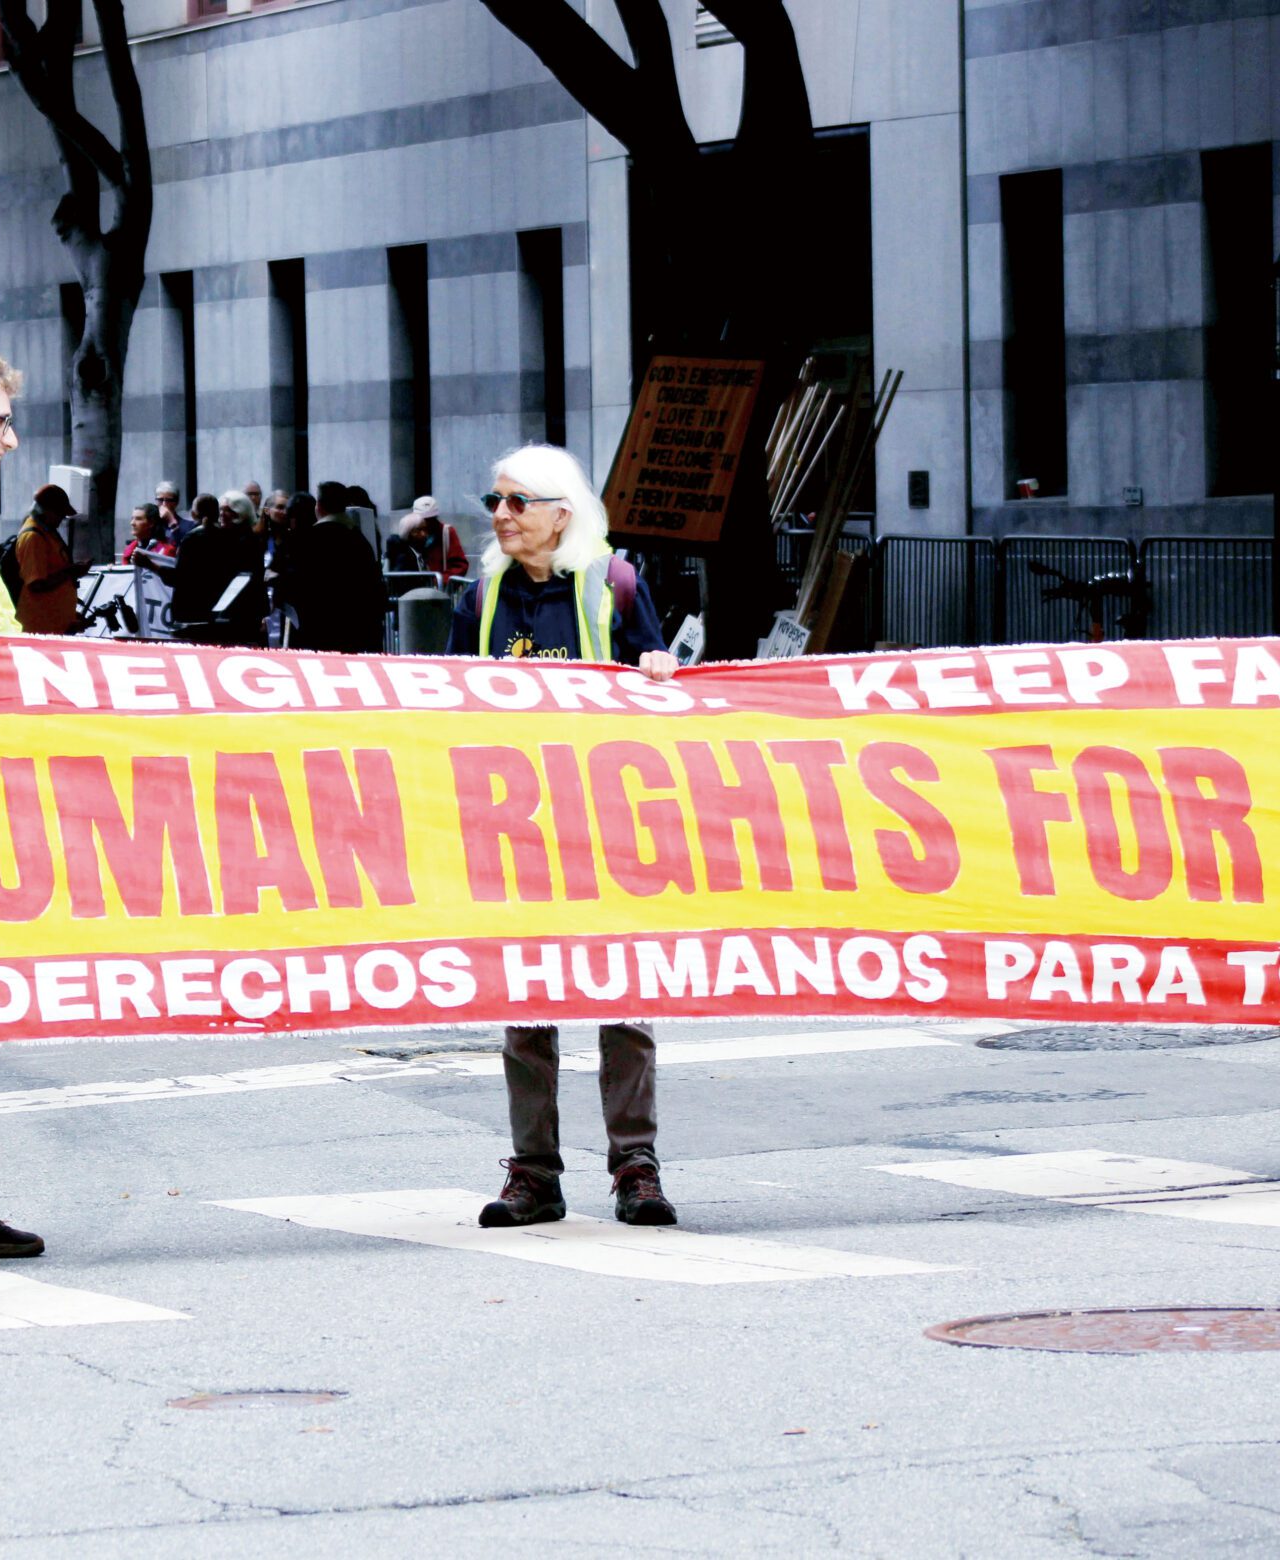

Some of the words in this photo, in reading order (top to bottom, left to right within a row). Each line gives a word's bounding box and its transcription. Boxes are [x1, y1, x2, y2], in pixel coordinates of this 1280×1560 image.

[657, 407, 695, 426] LOVE
[652, 427, 726, 449] NEIGHBOR
[646, 448, 714, 469] WELCOME
[631, 488, 673, 508] EVERY
[11, 647, 731, 713] NEIGHBORS.
[827, 649, 1130, 712] KEEP
[1163, 645, 1280, 706] FA
[450, 740, 961, 903] RIGHTS
[985, 743, 1265, 904] FOR
[502, 934, 949, 1003] HUMANOS
[985, 940, 1207, 1006] PARA
[1227, 950, 1280, 1006] T
